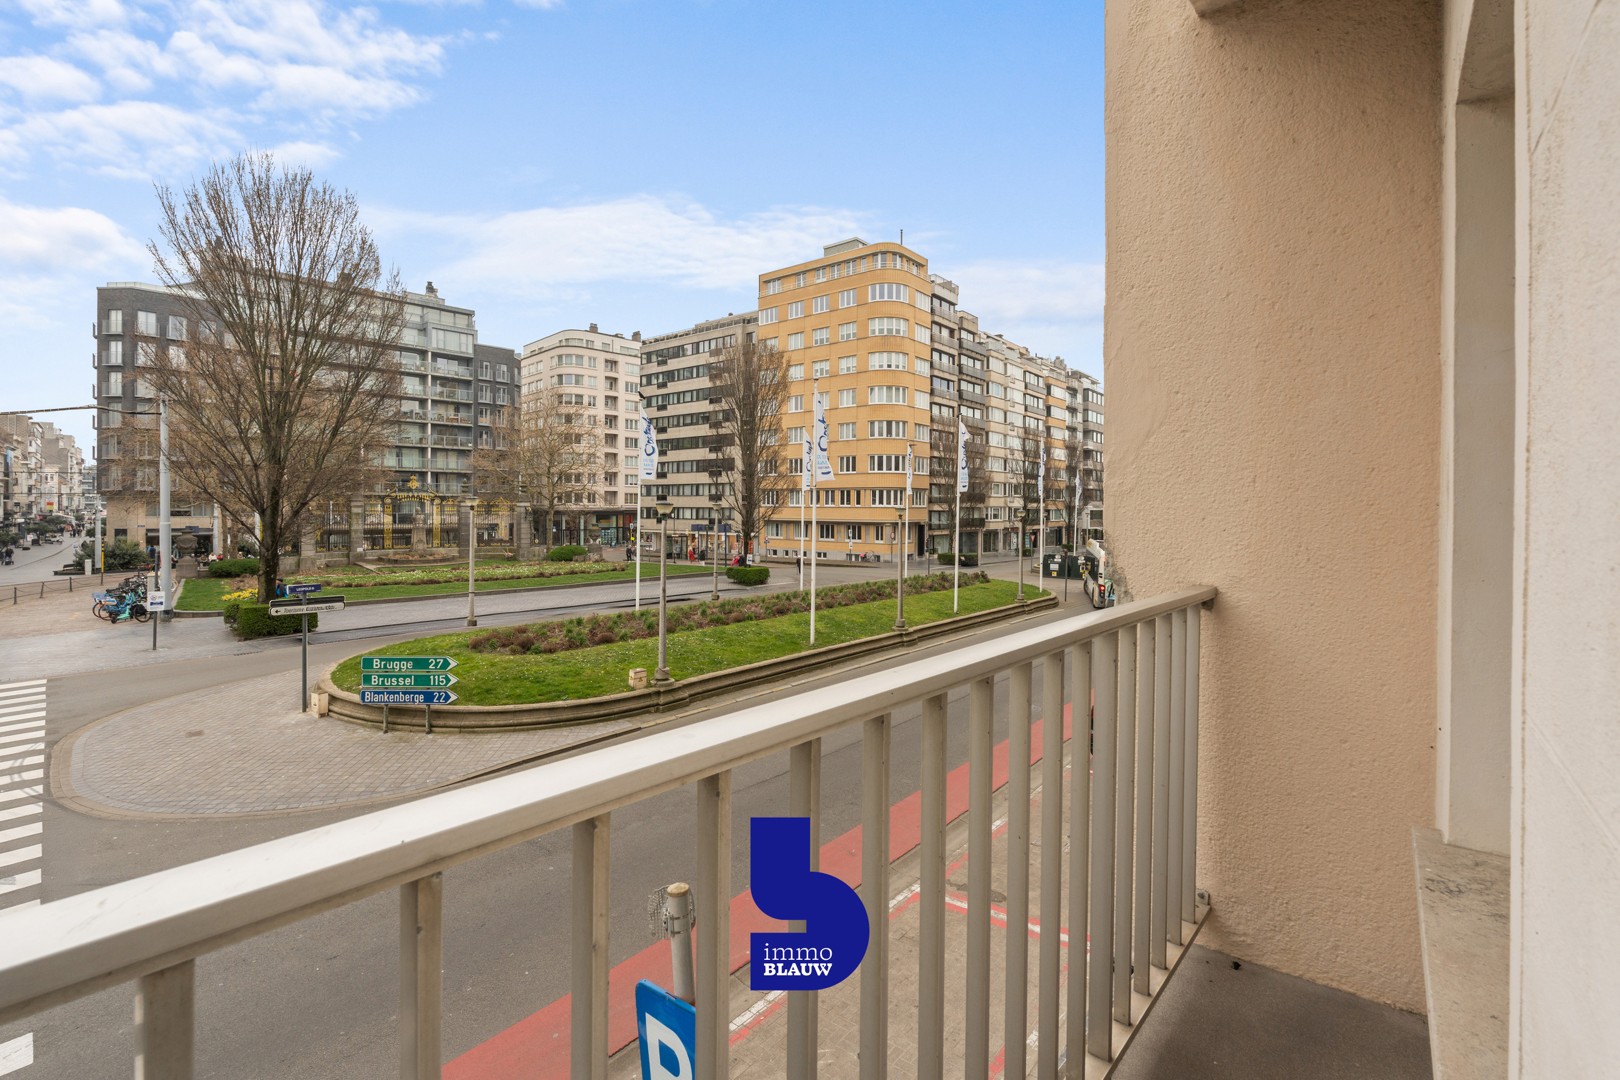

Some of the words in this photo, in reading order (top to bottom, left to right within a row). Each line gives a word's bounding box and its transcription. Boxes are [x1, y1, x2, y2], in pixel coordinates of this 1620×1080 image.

[373, 658, 413, 671] Brugge
[428, 658, 444, 669] 27
[371, 675, 415, 686] Brussel
[430, 675, 446, 686] 115
[364, 691, 425, 704] Blankenberge
[433, 692, 446, 703] 22
[645, 1012, 693, 1080] P
